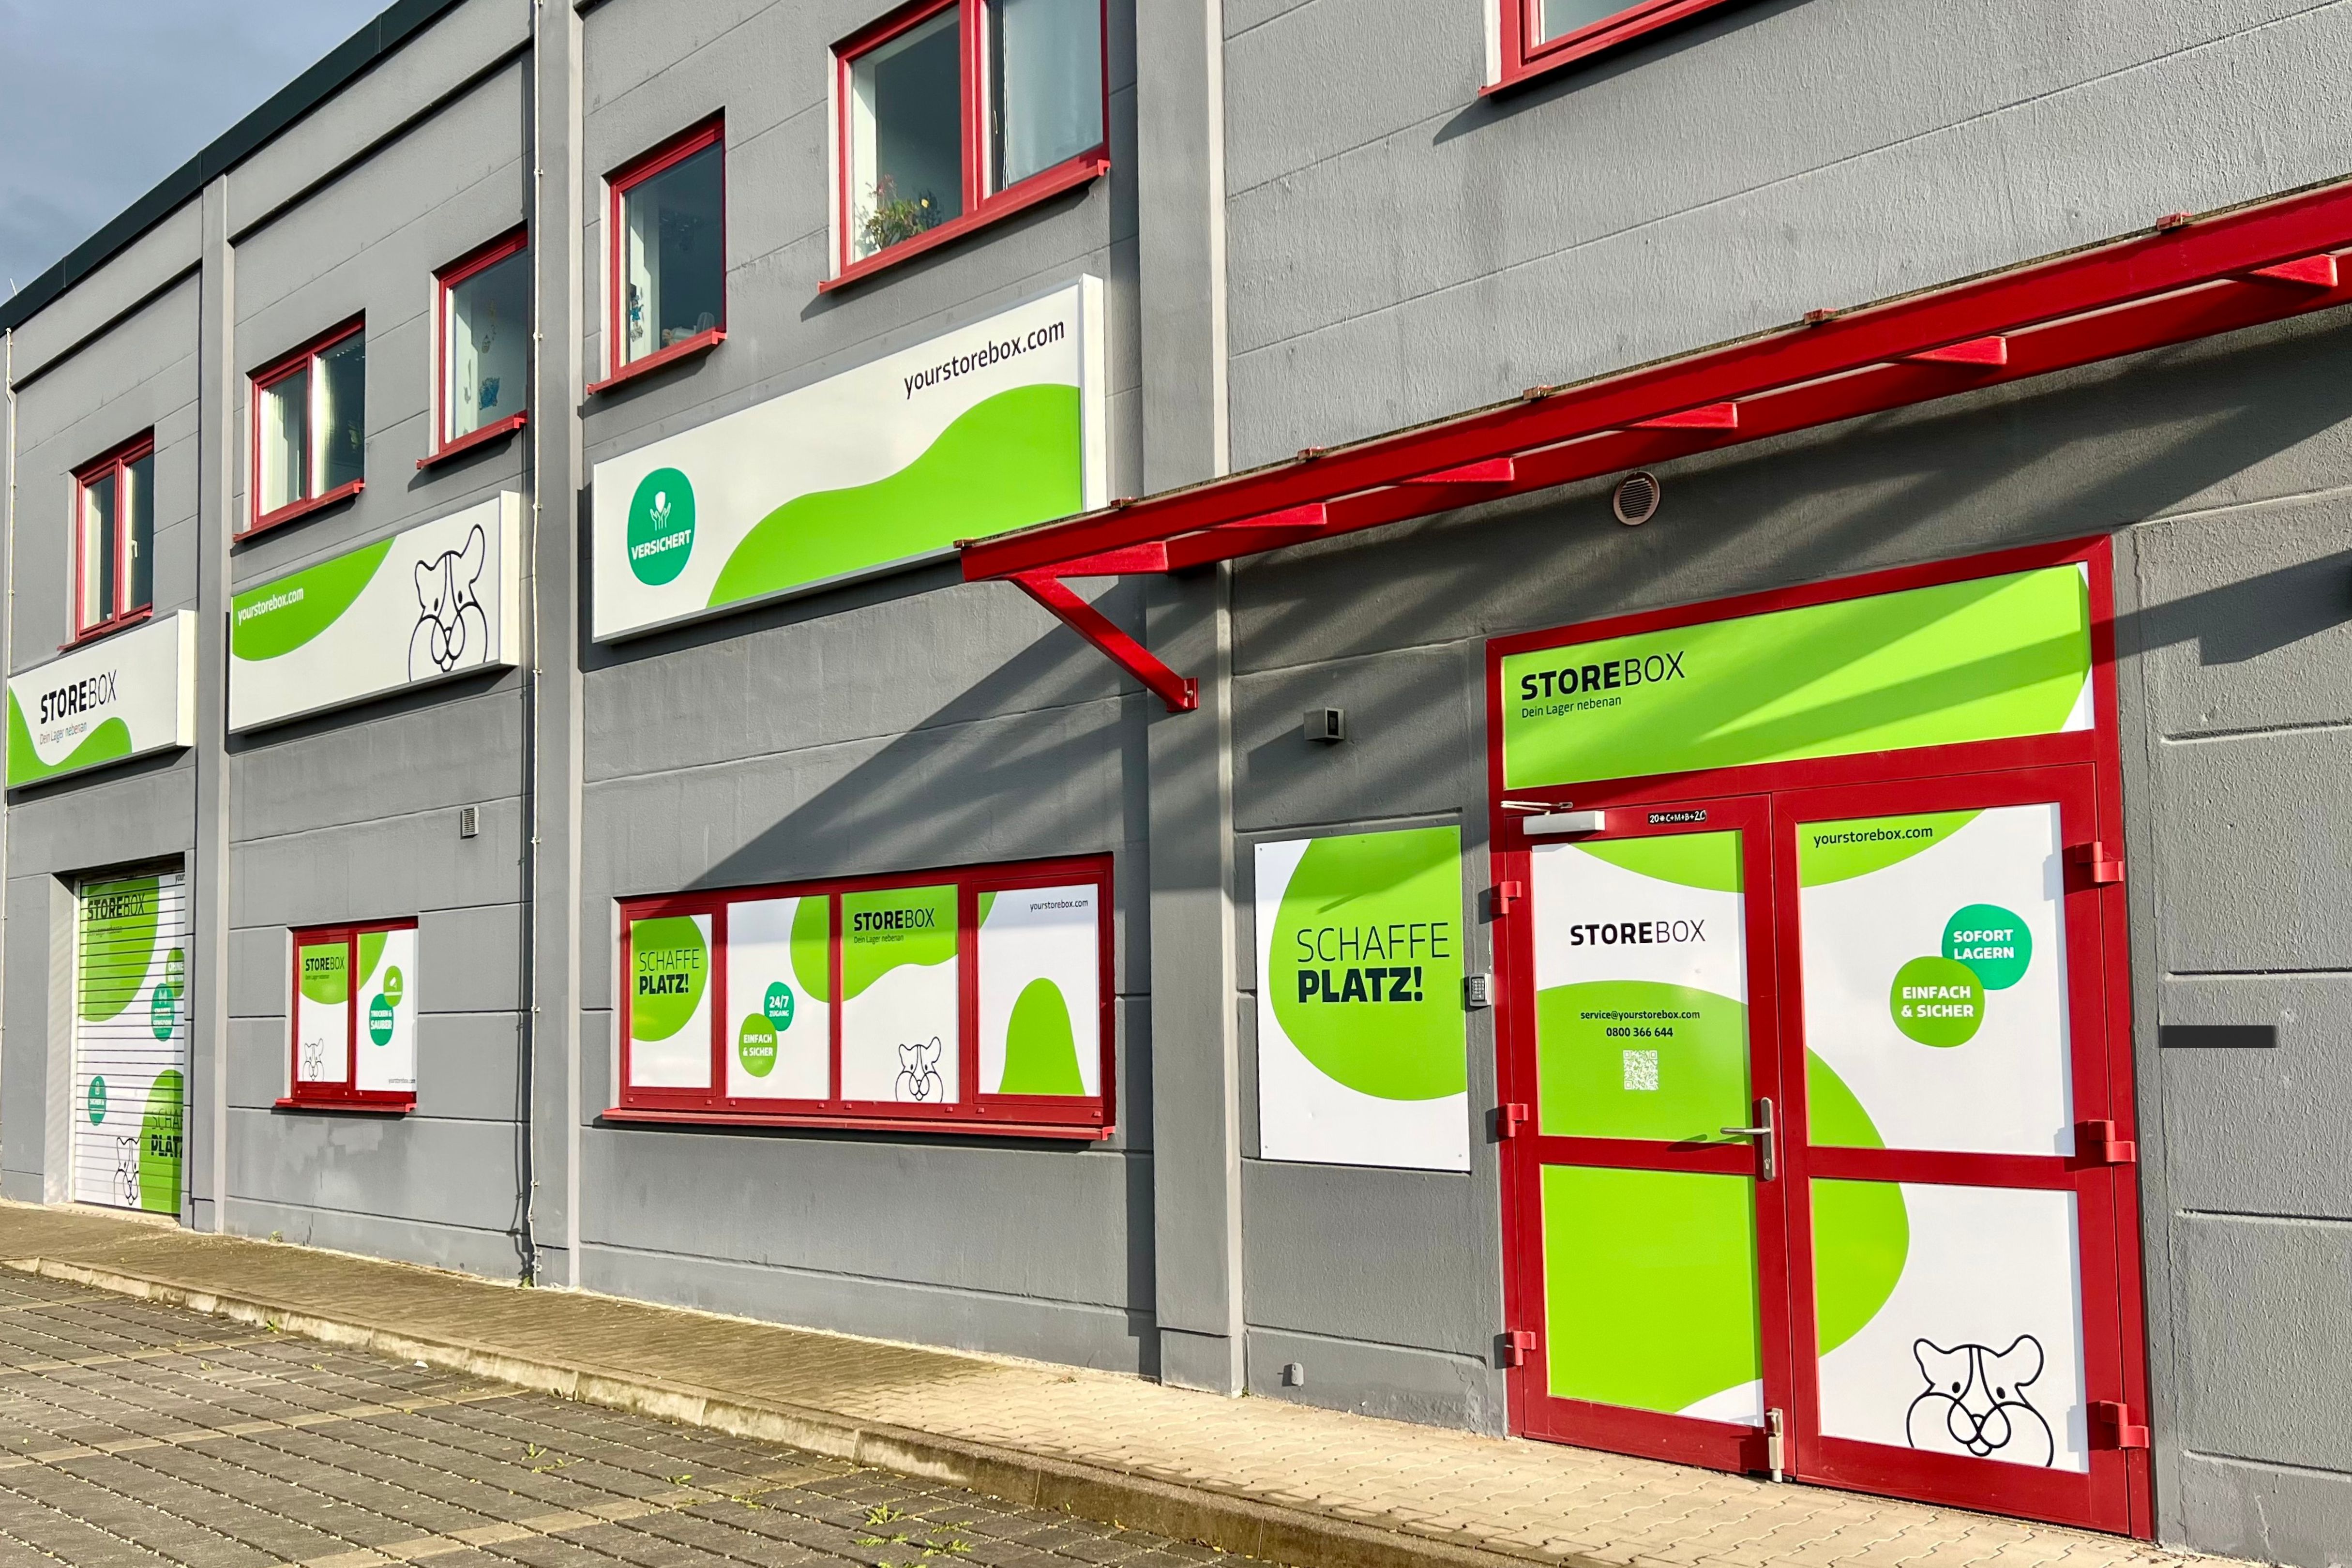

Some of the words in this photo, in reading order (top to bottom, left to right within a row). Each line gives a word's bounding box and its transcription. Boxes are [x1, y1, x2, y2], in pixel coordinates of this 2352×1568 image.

[904, 320, 1065, 400] yourstorebox.com
[631, 529, 692, 560] VERSICHERT
[238, 587, 304, 626] yourstorebox.com
[1521, 651, 1685, 700] STOREBOX
[40, 669, 117, 724] STOREBOX
[1522, 705, 1544, 718] Dein
[1546, 703, 1575, 716] Lager
[1577, 696, 1622, 711] nebenan
[40, 731, 50, 745] Dein
[51, 728, 65, 743] Lager
[65, 722, 87, 737] nebenan
[1813, 828, 1933, 848] yourstorebox.com
[88, 893, 145, 920] STOREBOX
[1029, 900, 1088, 912] yourstorebox.com
[854, 908, 935, 931] STOREBOX
[854, 935, 865, 944] Dein
[866, 935, 881, 945] Lager
[881, 934, 904, 942] nebenan
[1297, 921, 1450, 963] SCHAFFE
[1570, 919, 1705, 946] STOREBOX
[1953, 928, 2014, 943] SOFORT
[639, 949, 700, 972] SCHAFFE
[1953, 946, 2015, 960] LAGERN
[305, 956, 345, 972] STOREBOX
[639, 973, 689, 995] PLATZ!
[1297, 966, 1423, 1004] PLATZ!
[1902, 985, 1971, 999] EINFACH
[769, 995, 789, 1009] 24/7
[1901, 1004, 1913, 1018] &
[1916, 1004, 1975, 1018] SICHER
[370, 1019, 392, 1030] SAUBER
[1580, 1010, 1701, 1021] service@yourstorebox.com
[743, 1034, 772, 1044] EINFACH
[1606, 1027, 1630, 1037] 0800
[1633, 1027, 1652, 1037] 366
[1654, 1027, 1674, 1037] 644
[742, 1047, 748, 1056] &
[749, 1047, 773, 1056] SICHER
